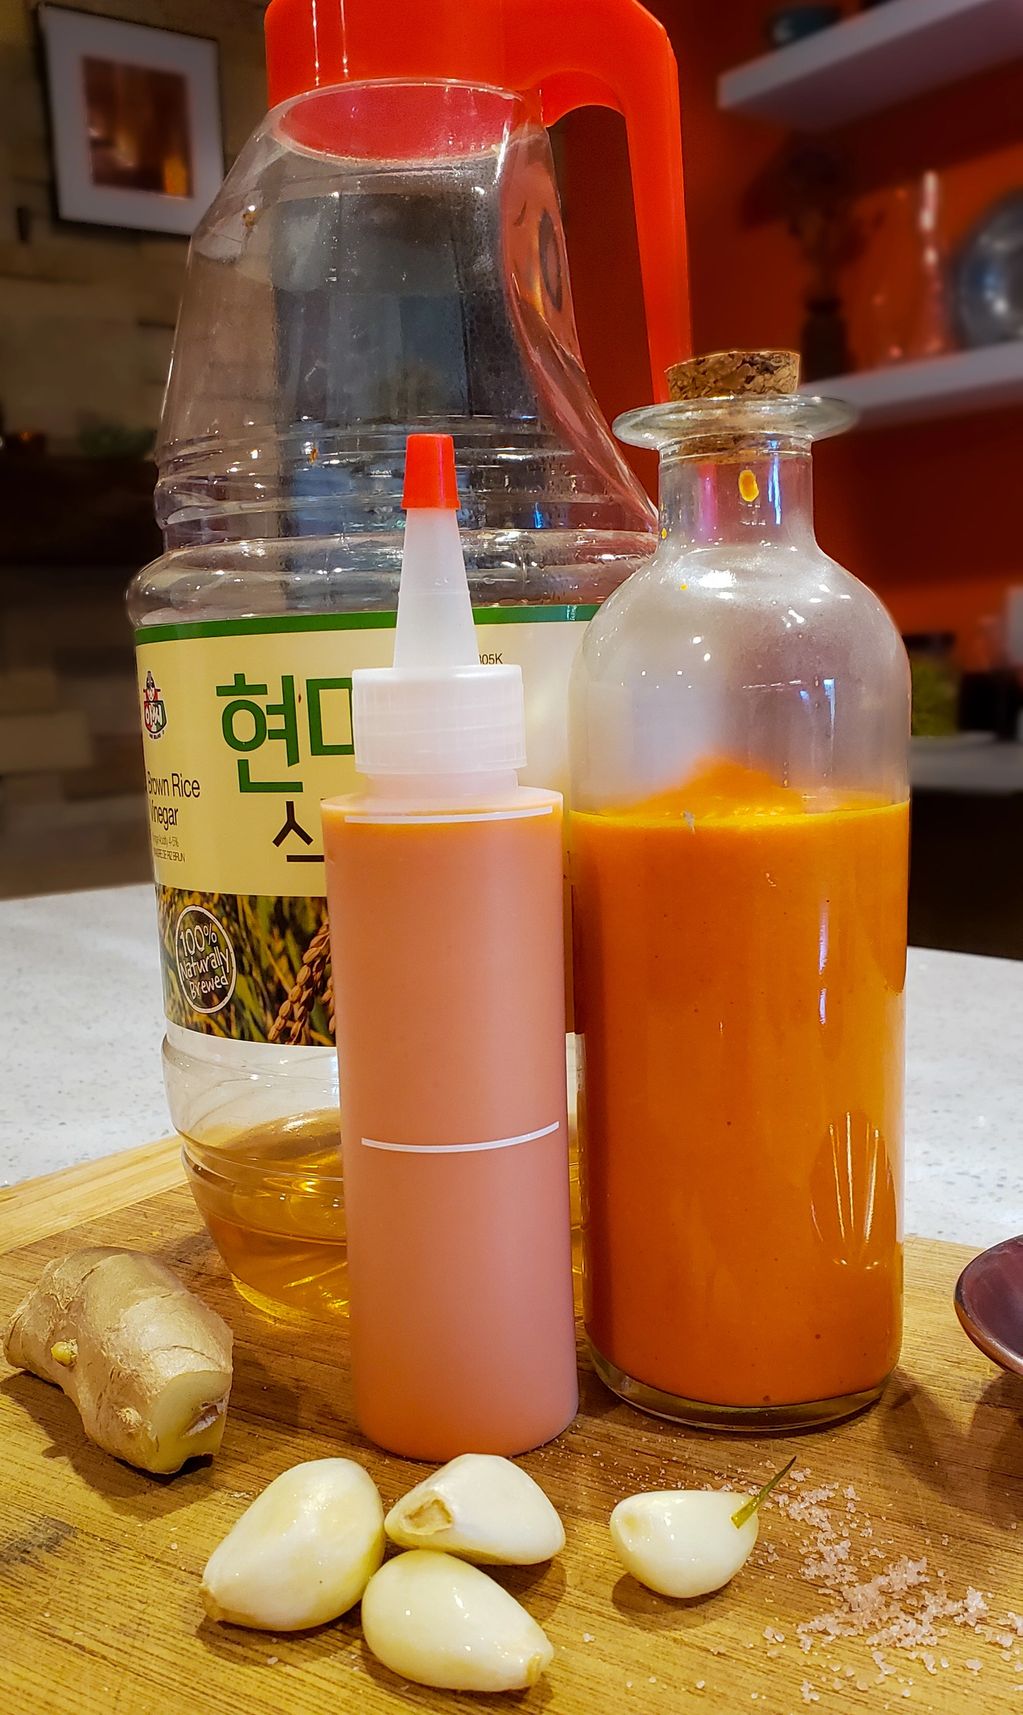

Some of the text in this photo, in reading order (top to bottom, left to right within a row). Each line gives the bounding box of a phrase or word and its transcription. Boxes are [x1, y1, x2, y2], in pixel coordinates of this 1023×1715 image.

[171, 773, 201, 798] Rice
[180, 923, 218, 957] 100%
[180, 946, 230, 981] Naturally
[189, 966, 229, 1000] Brewed
